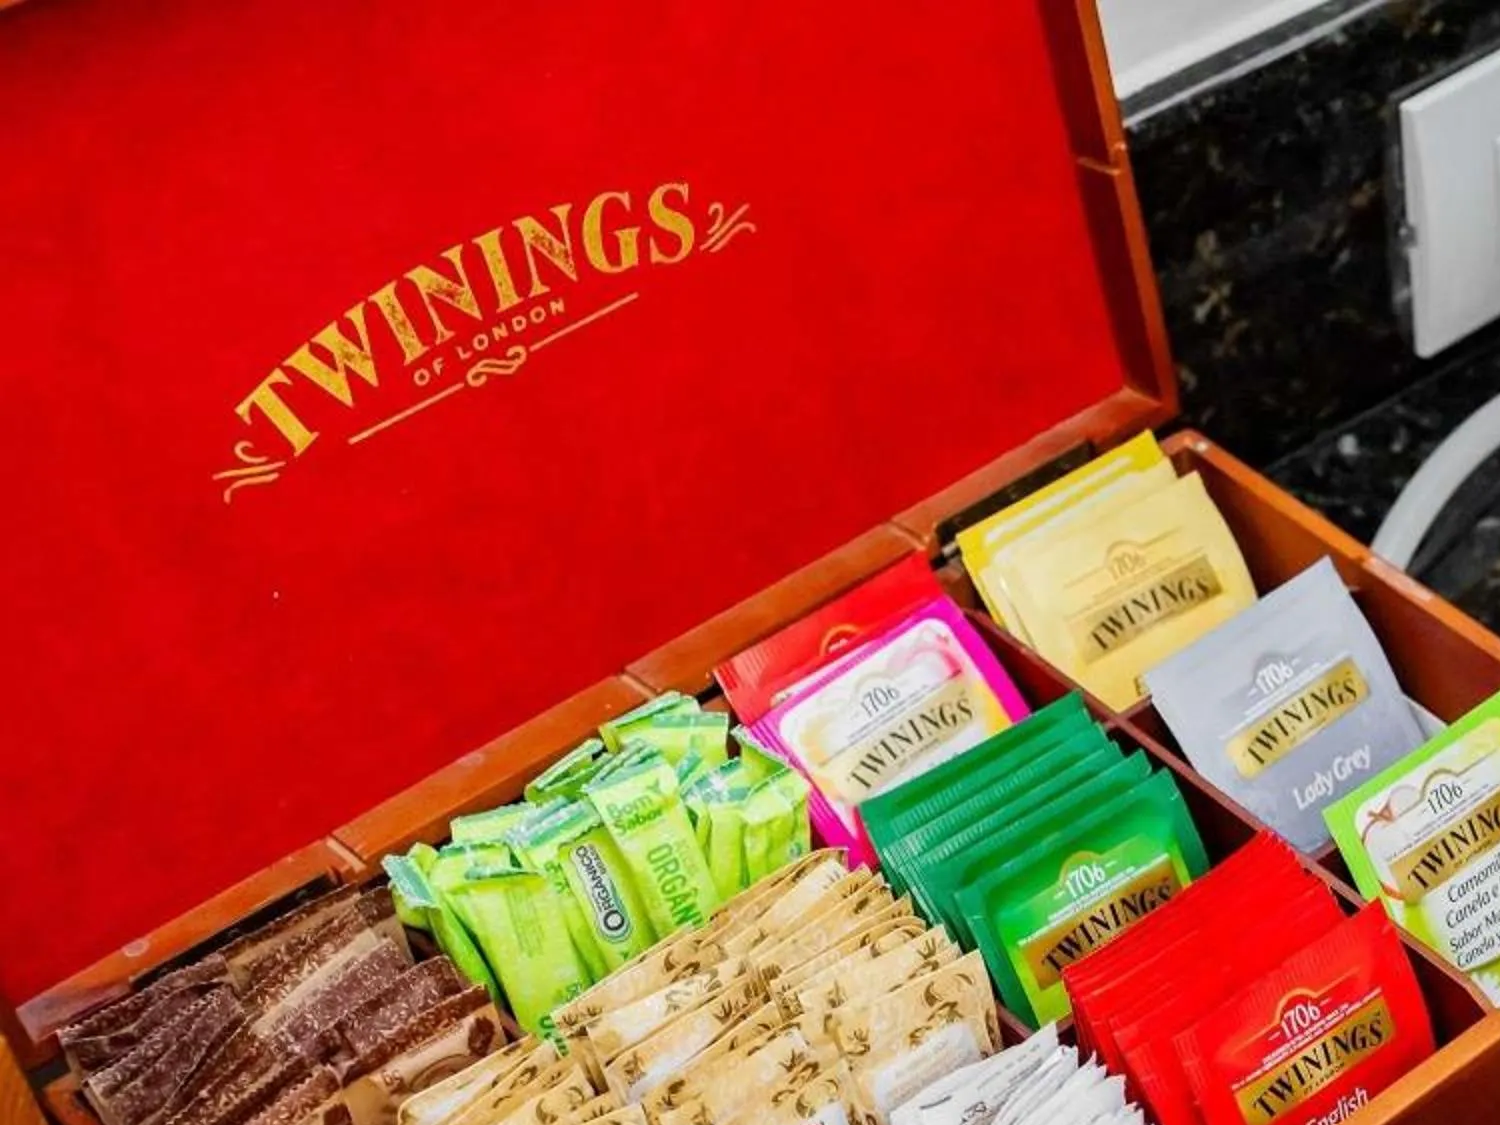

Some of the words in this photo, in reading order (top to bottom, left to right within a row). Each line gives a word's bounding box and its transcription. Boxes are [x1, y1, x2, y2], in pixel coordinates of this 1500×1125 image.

[234, 182, 695, 457] TWININGS
[413, 358, 446, 387] OF
[456, 298, 567, 362] LONDON
[1087, 577, 1211, 650] TWININGS
[1256, 661, 1294, 695] 1706
[861, 686, 900, 717] 1706
[1243, 677, 1358, 765] TWININGS
[847, 697, 974, 789] TWININGS
[1292, 770, 1335, 810] Lady
[1333, 744, 1371, 782] Grey
[1428, 782, 1464, 815] 1706
[614, 808, 663, 837] Sabor
[1065, 863, 1106, 898] 1706
[1041, 882, 1173, 972] TWININGS
[1446, 891, 1492, 929] Canela
[1450, 921, 1484, 953] Sabor
[1457, 937, 1494, 968] Canela
[1279, 1001, 1321, 1041] 1706
[1252, 1019, 1385, 1119] TWININGS
